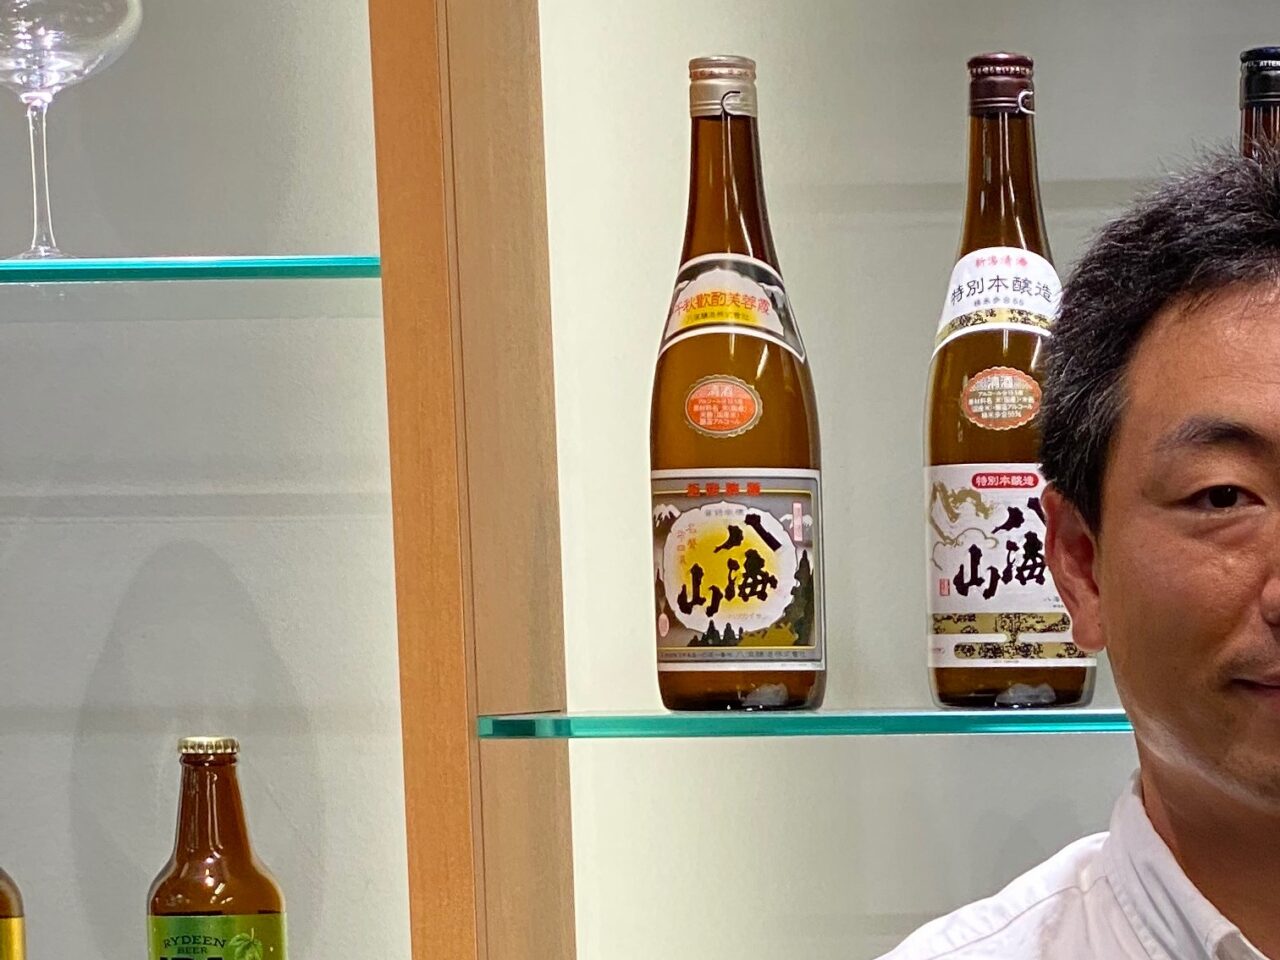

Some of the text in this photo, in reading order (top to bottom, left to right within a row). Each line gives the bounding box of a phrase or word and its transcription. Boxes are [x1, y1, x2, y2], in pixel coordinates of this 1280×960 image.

[951, 274, 1054, 305] 特別本醸造
[975, 475, 1035, 487] 特別本醸造
[164, 935, 227, 949] RYDEEN
[177, 946, 208, 954] BEER
